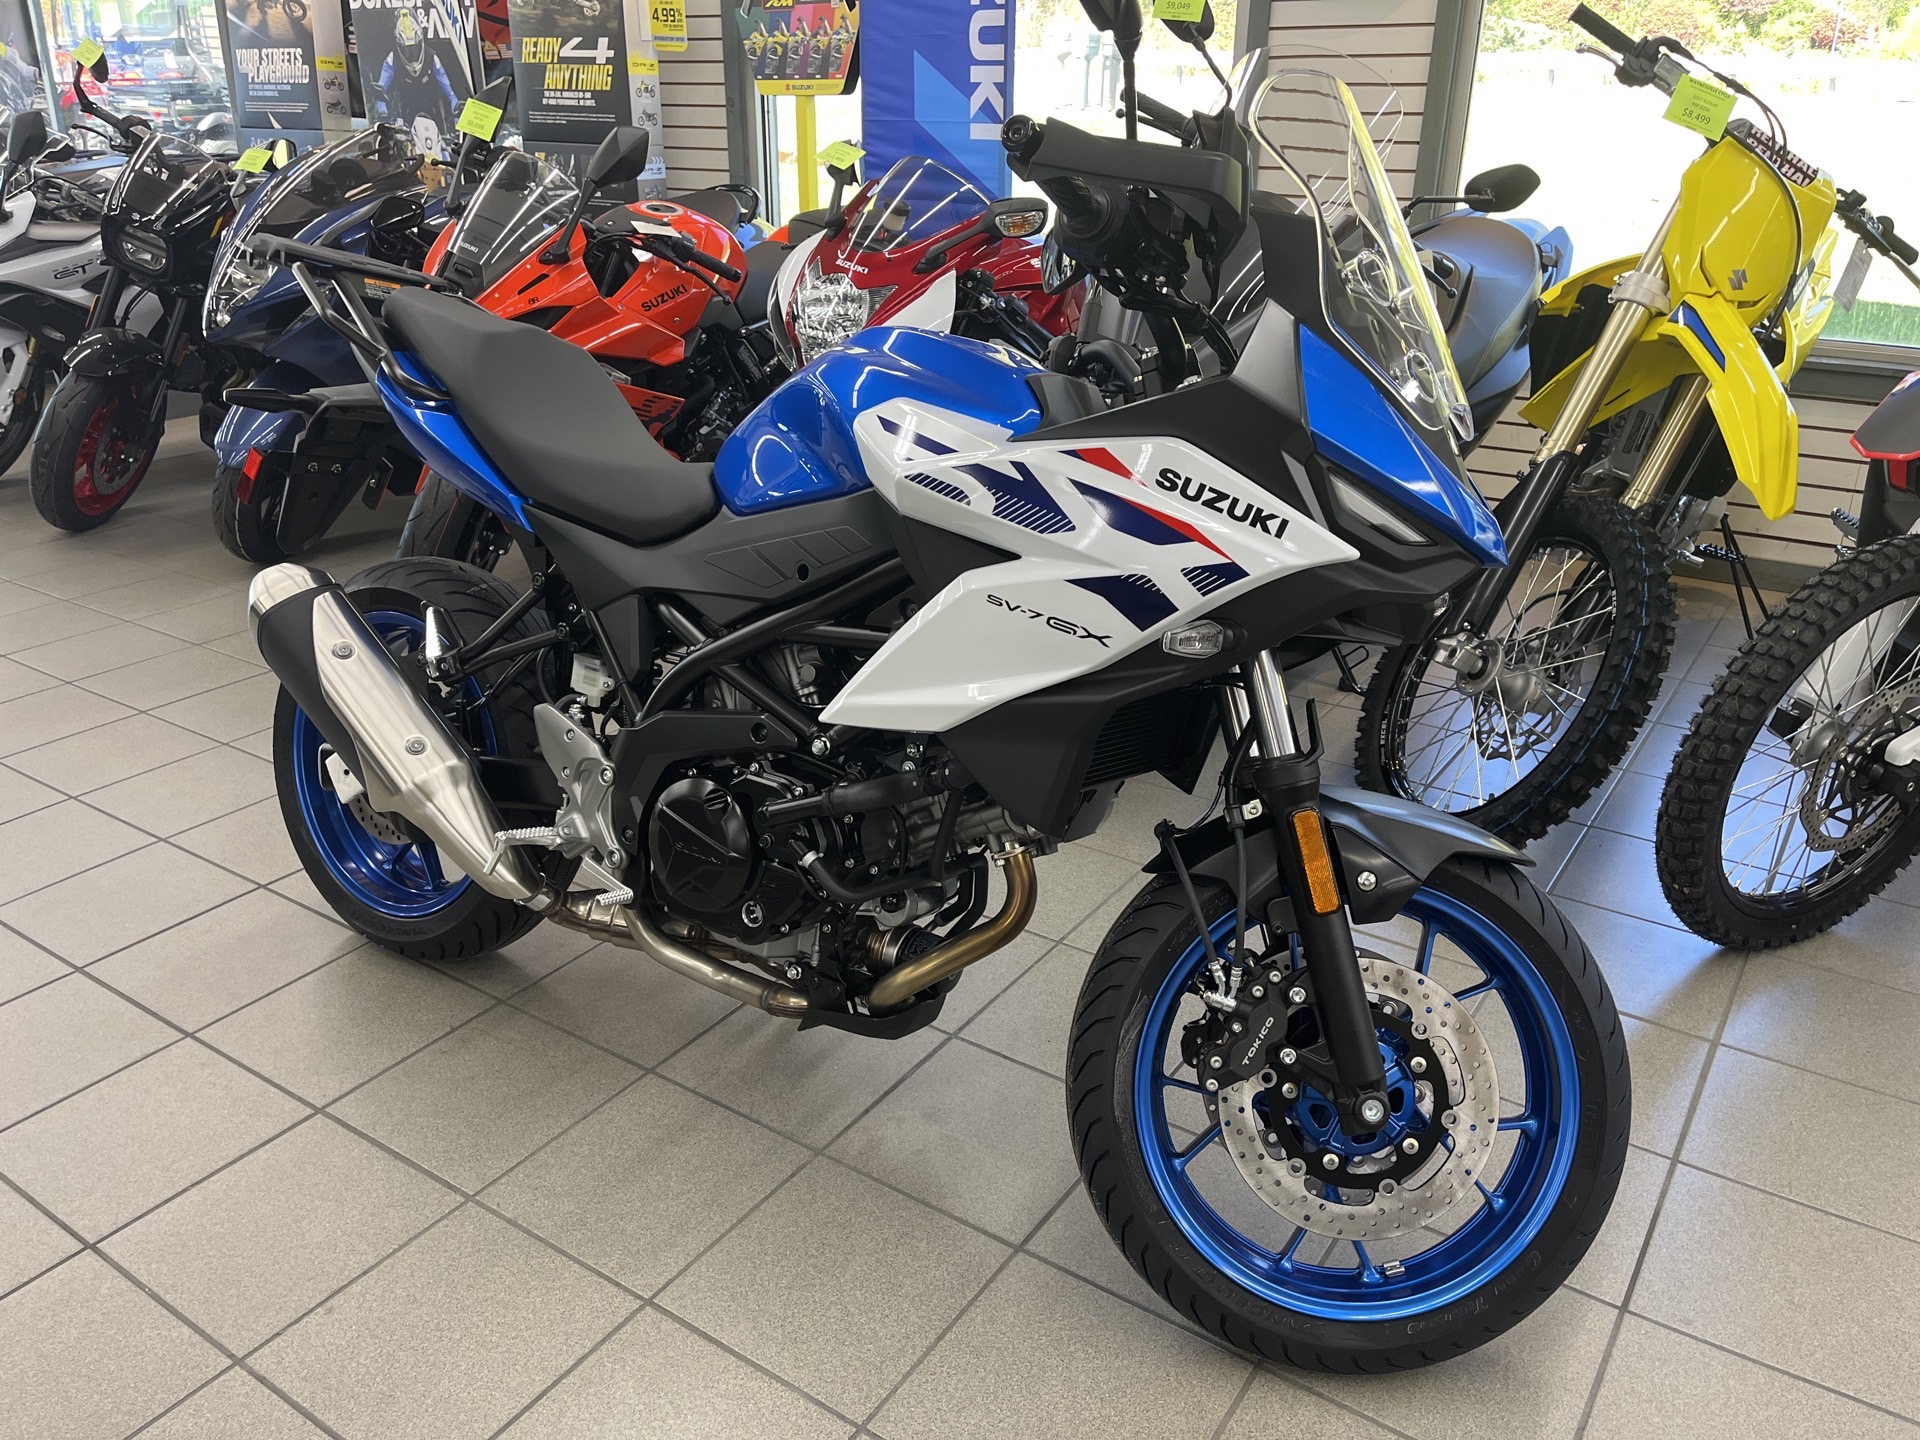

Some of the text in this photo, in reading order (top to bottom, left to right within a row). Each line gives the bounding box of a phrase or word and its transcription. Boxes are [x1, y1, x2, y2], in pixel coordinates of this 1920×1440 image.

[236, 47, 303, 67] YOUR STREETS
[522, 37, 615, 64] READY 4
[248, 64, 310, 84] PLAYGROUND
[544, 64, 613, 90] ANYTHING
[969, 0, 1005, 140] UKI
[1682, 107, 1711, 125] $8,499
[459, 241, 479, 253] SUZUKI
[53, 261, 94, 280] GT
[835, 258, 869, 274] SUZUKI
[641, 283, 688, 313] SUZUKI
[1155, 467, 1290, 540] SUZUKI
[1241, 1016, 1275, 1065] TOKICO
